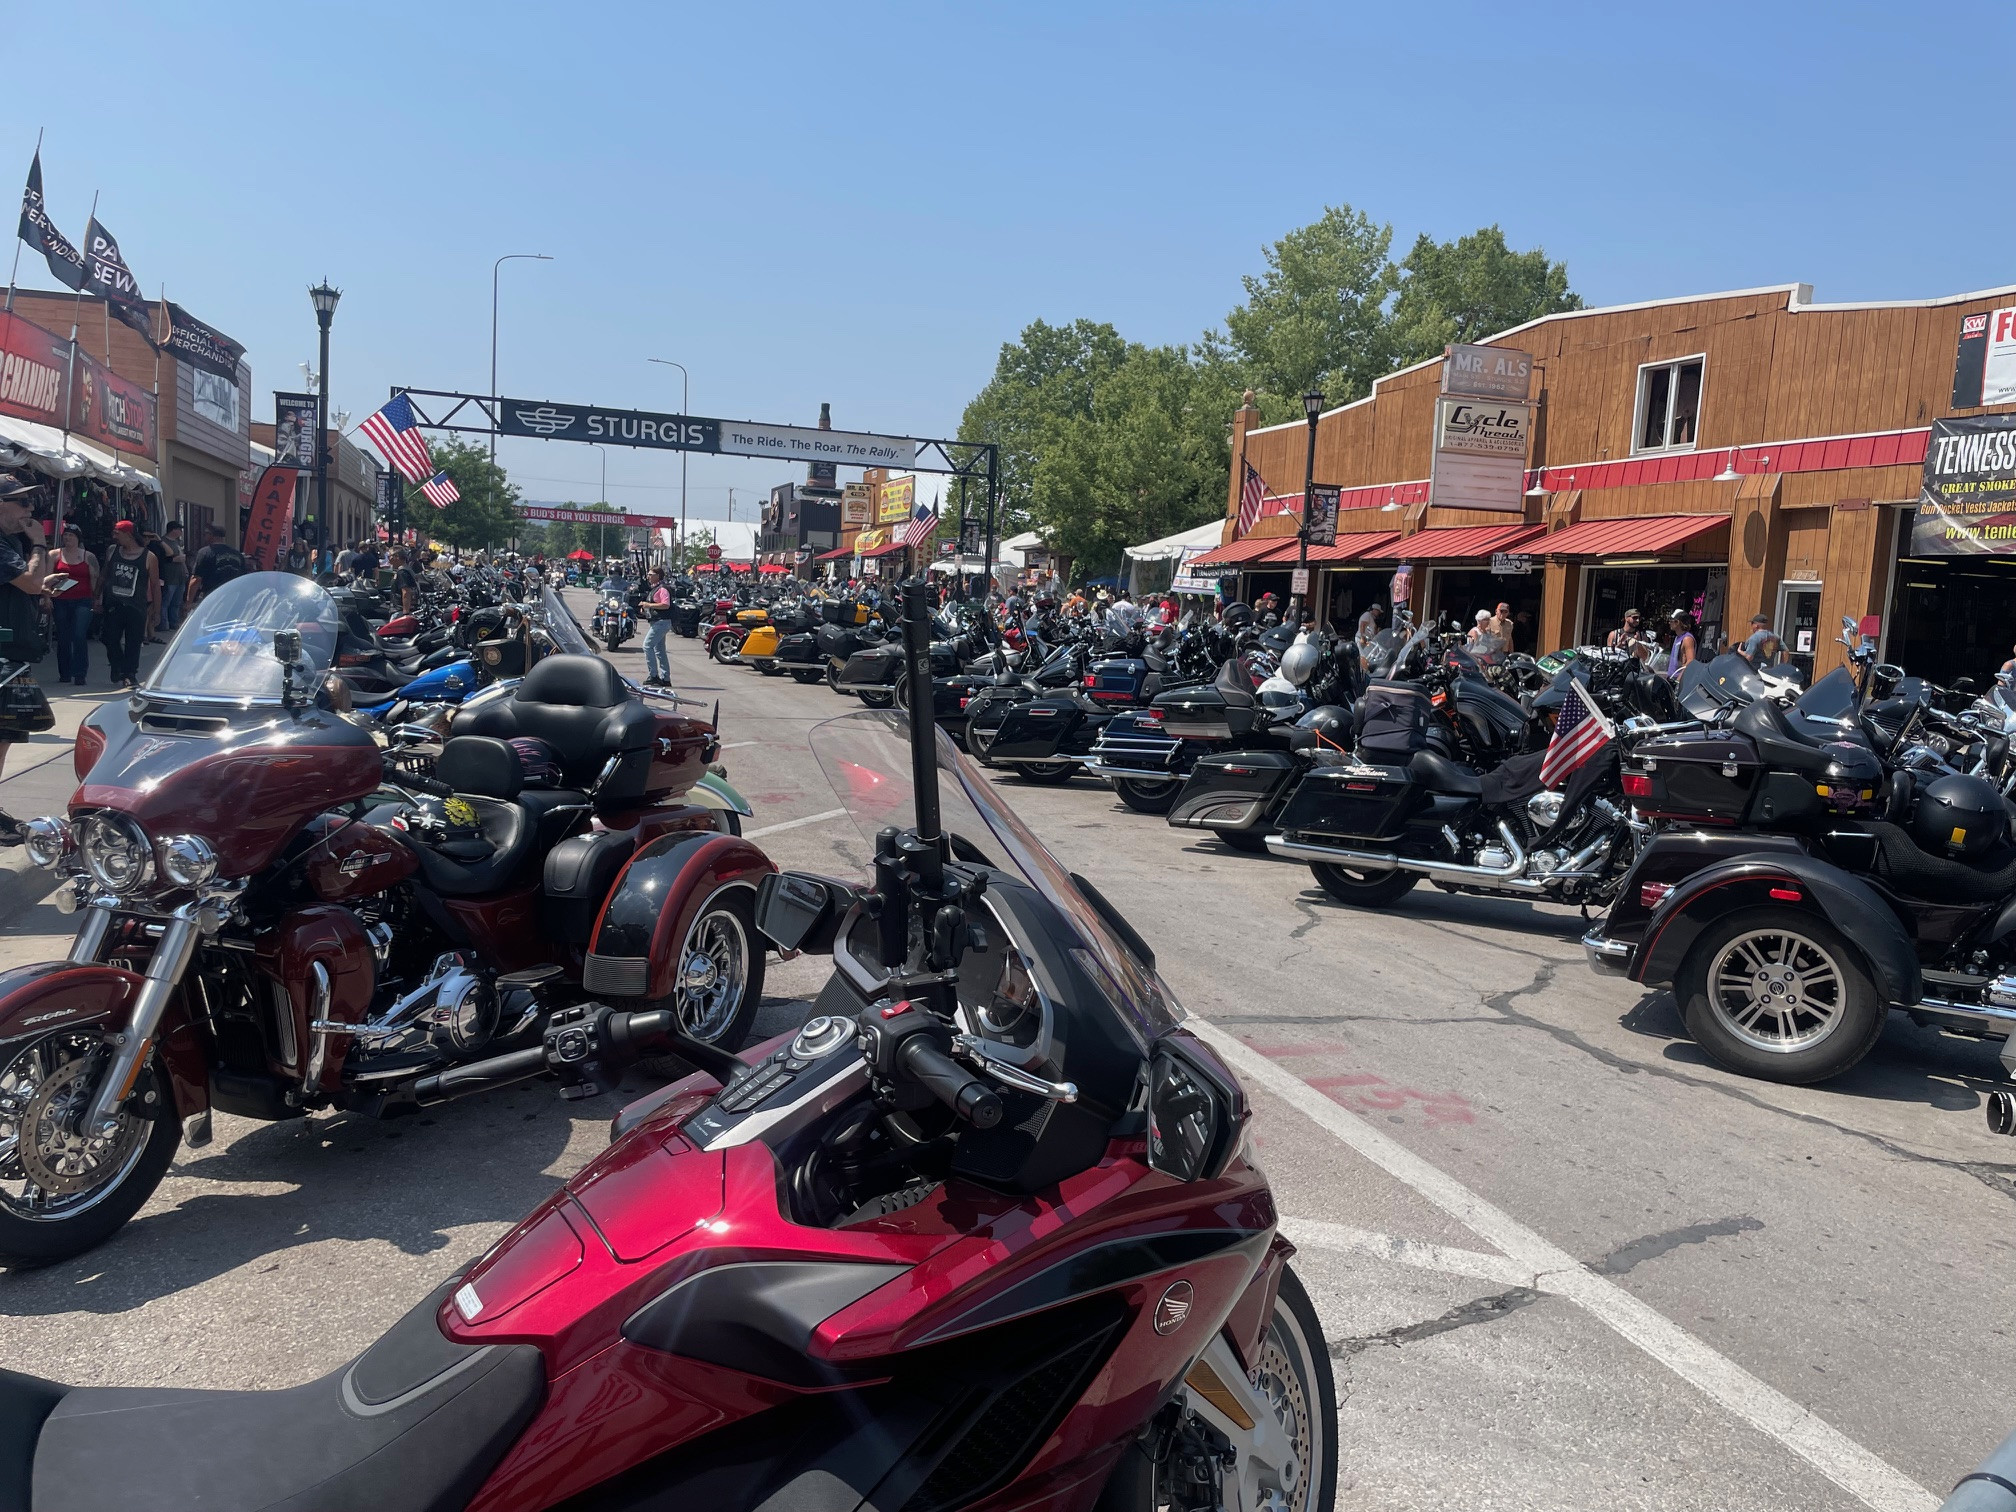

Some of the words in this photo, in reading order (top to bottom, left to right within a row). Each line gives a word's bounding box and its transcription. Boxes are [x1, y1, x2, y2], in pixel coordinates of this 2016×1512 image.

[1965, 318, 1986, 331] KW
[1456, 353, 1488, 374] MR.
[1494, 357, 1528, 378] AL'S
[280, 398, 304, 407] WELCOME
[1446, 405, 1518, 434] Cycle
[301, 409, 313, 466] STURGIS
[587, 415, 704, 445] STURGIS
[1473, 425, 1524, 439] Threads
[732, 433, 754, 445] The
[757, 437, 787, 448] Ride.
[790, 439, 811, 451] The
[814, 442, 843, 453] Roar.
[846, 444, 867, 455] The
[868, 447, 899, 459] Rally.
[1941, 482, 1977, 494] GREAT
[1920, 504, 1936, 515] Gun
[1937, 502, 1963, 514] Pocket
[1965, 501, 1987, 513] Vests
[530, 509, 555, 519] BUD'S
[556, 510, 572, 521] FOR
[574, 512, 590, 523] YOU
[591, 513, 626, 525] STURGIS
[1324, 497, 1337, 544] STURGIS
[707, 548, 721, 556] STOP
[1159, 1314, 1186, 1328] HONDA
